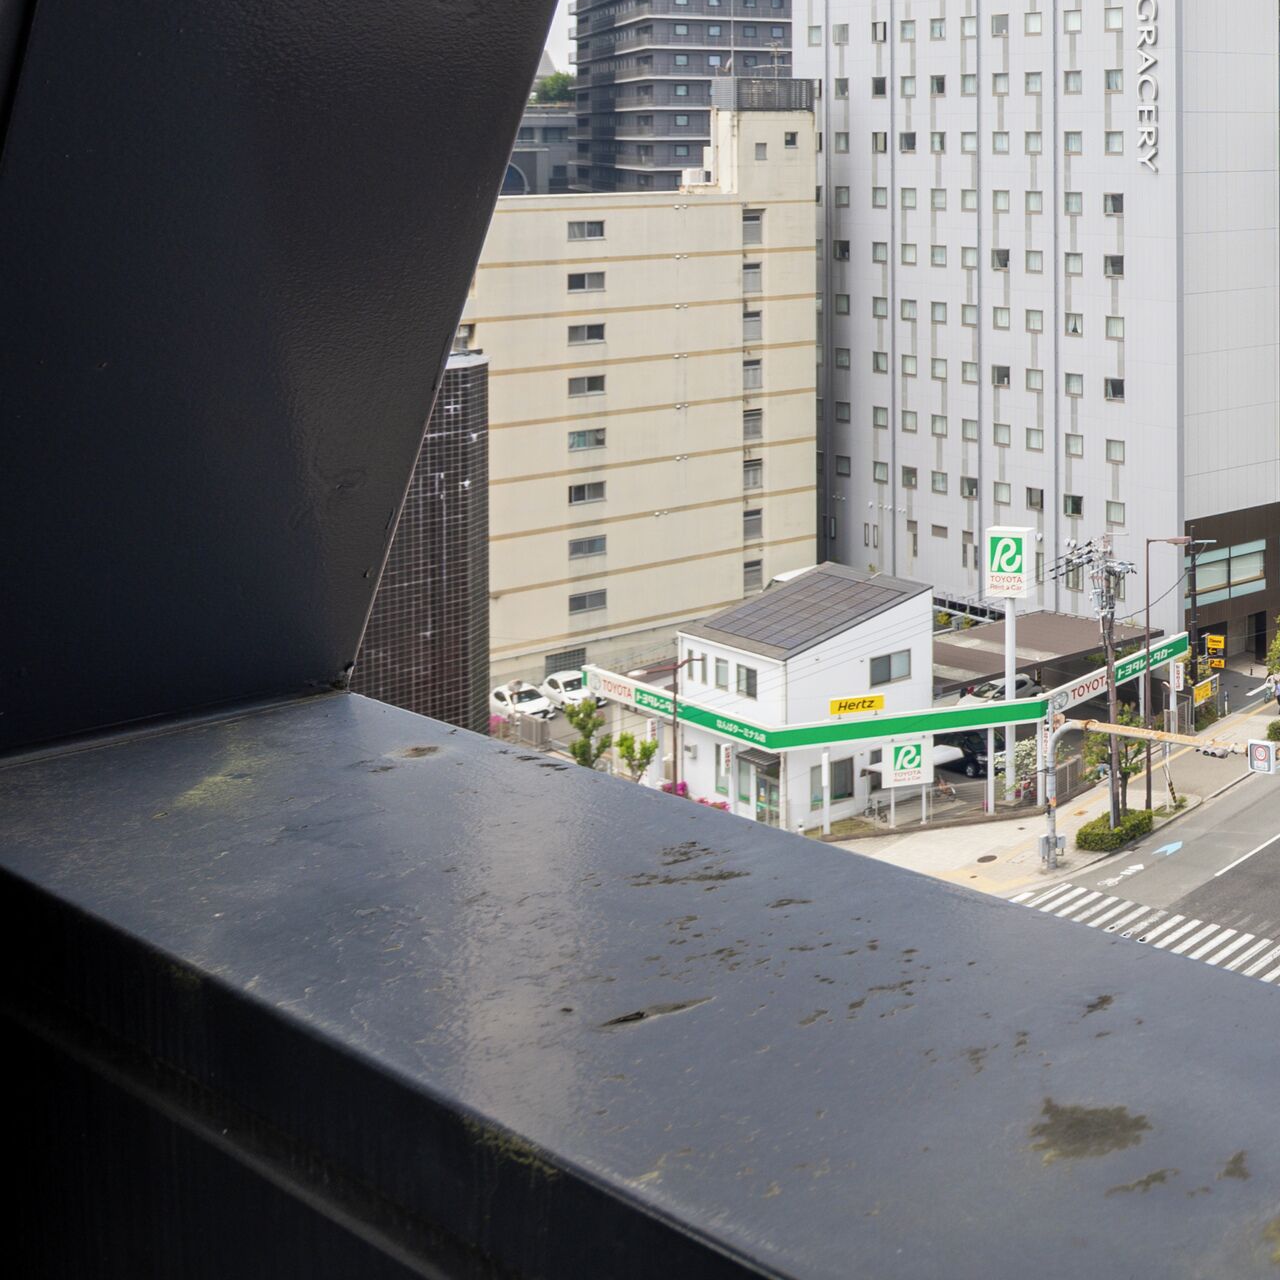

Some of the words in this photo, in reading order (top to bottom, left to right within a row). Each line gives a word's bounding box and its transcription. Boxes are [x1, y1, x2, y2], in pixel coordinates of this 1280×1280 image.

[990, 575, 1023, 583] TOYOTA
[602, 679, 633, 699] TOYOTA
[1071, 675, 1108, 700] TOYOT
[837, 699, 875, 711] Hertz
